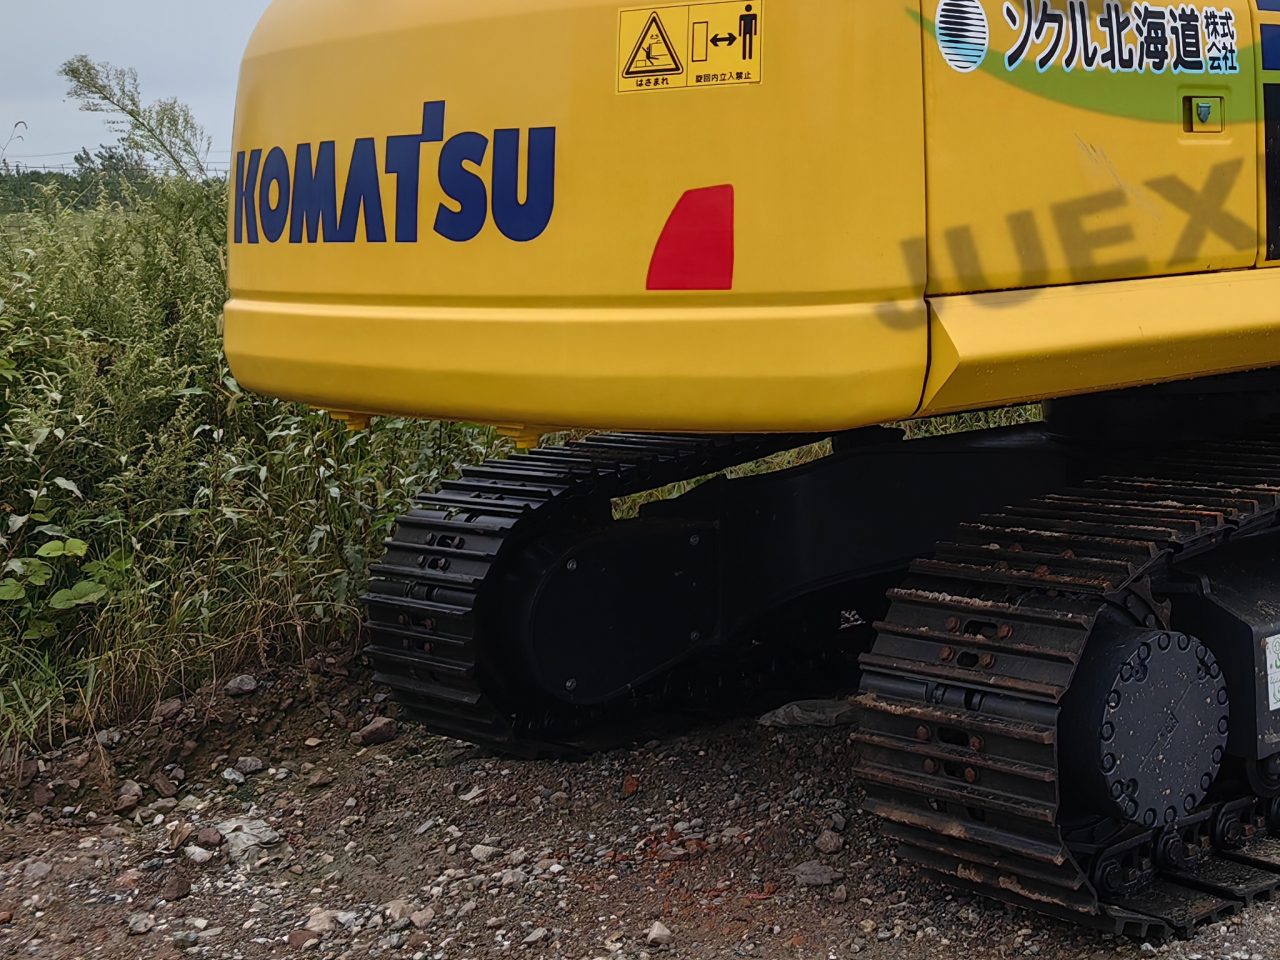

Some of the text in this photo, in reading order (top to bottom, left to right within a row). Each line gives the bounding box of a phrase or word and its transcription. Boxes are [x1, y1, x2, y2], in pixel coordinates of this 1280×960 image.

[635, 77, 669, 87] はさまれ
[234, 100, 556, 244] KOMATSU
